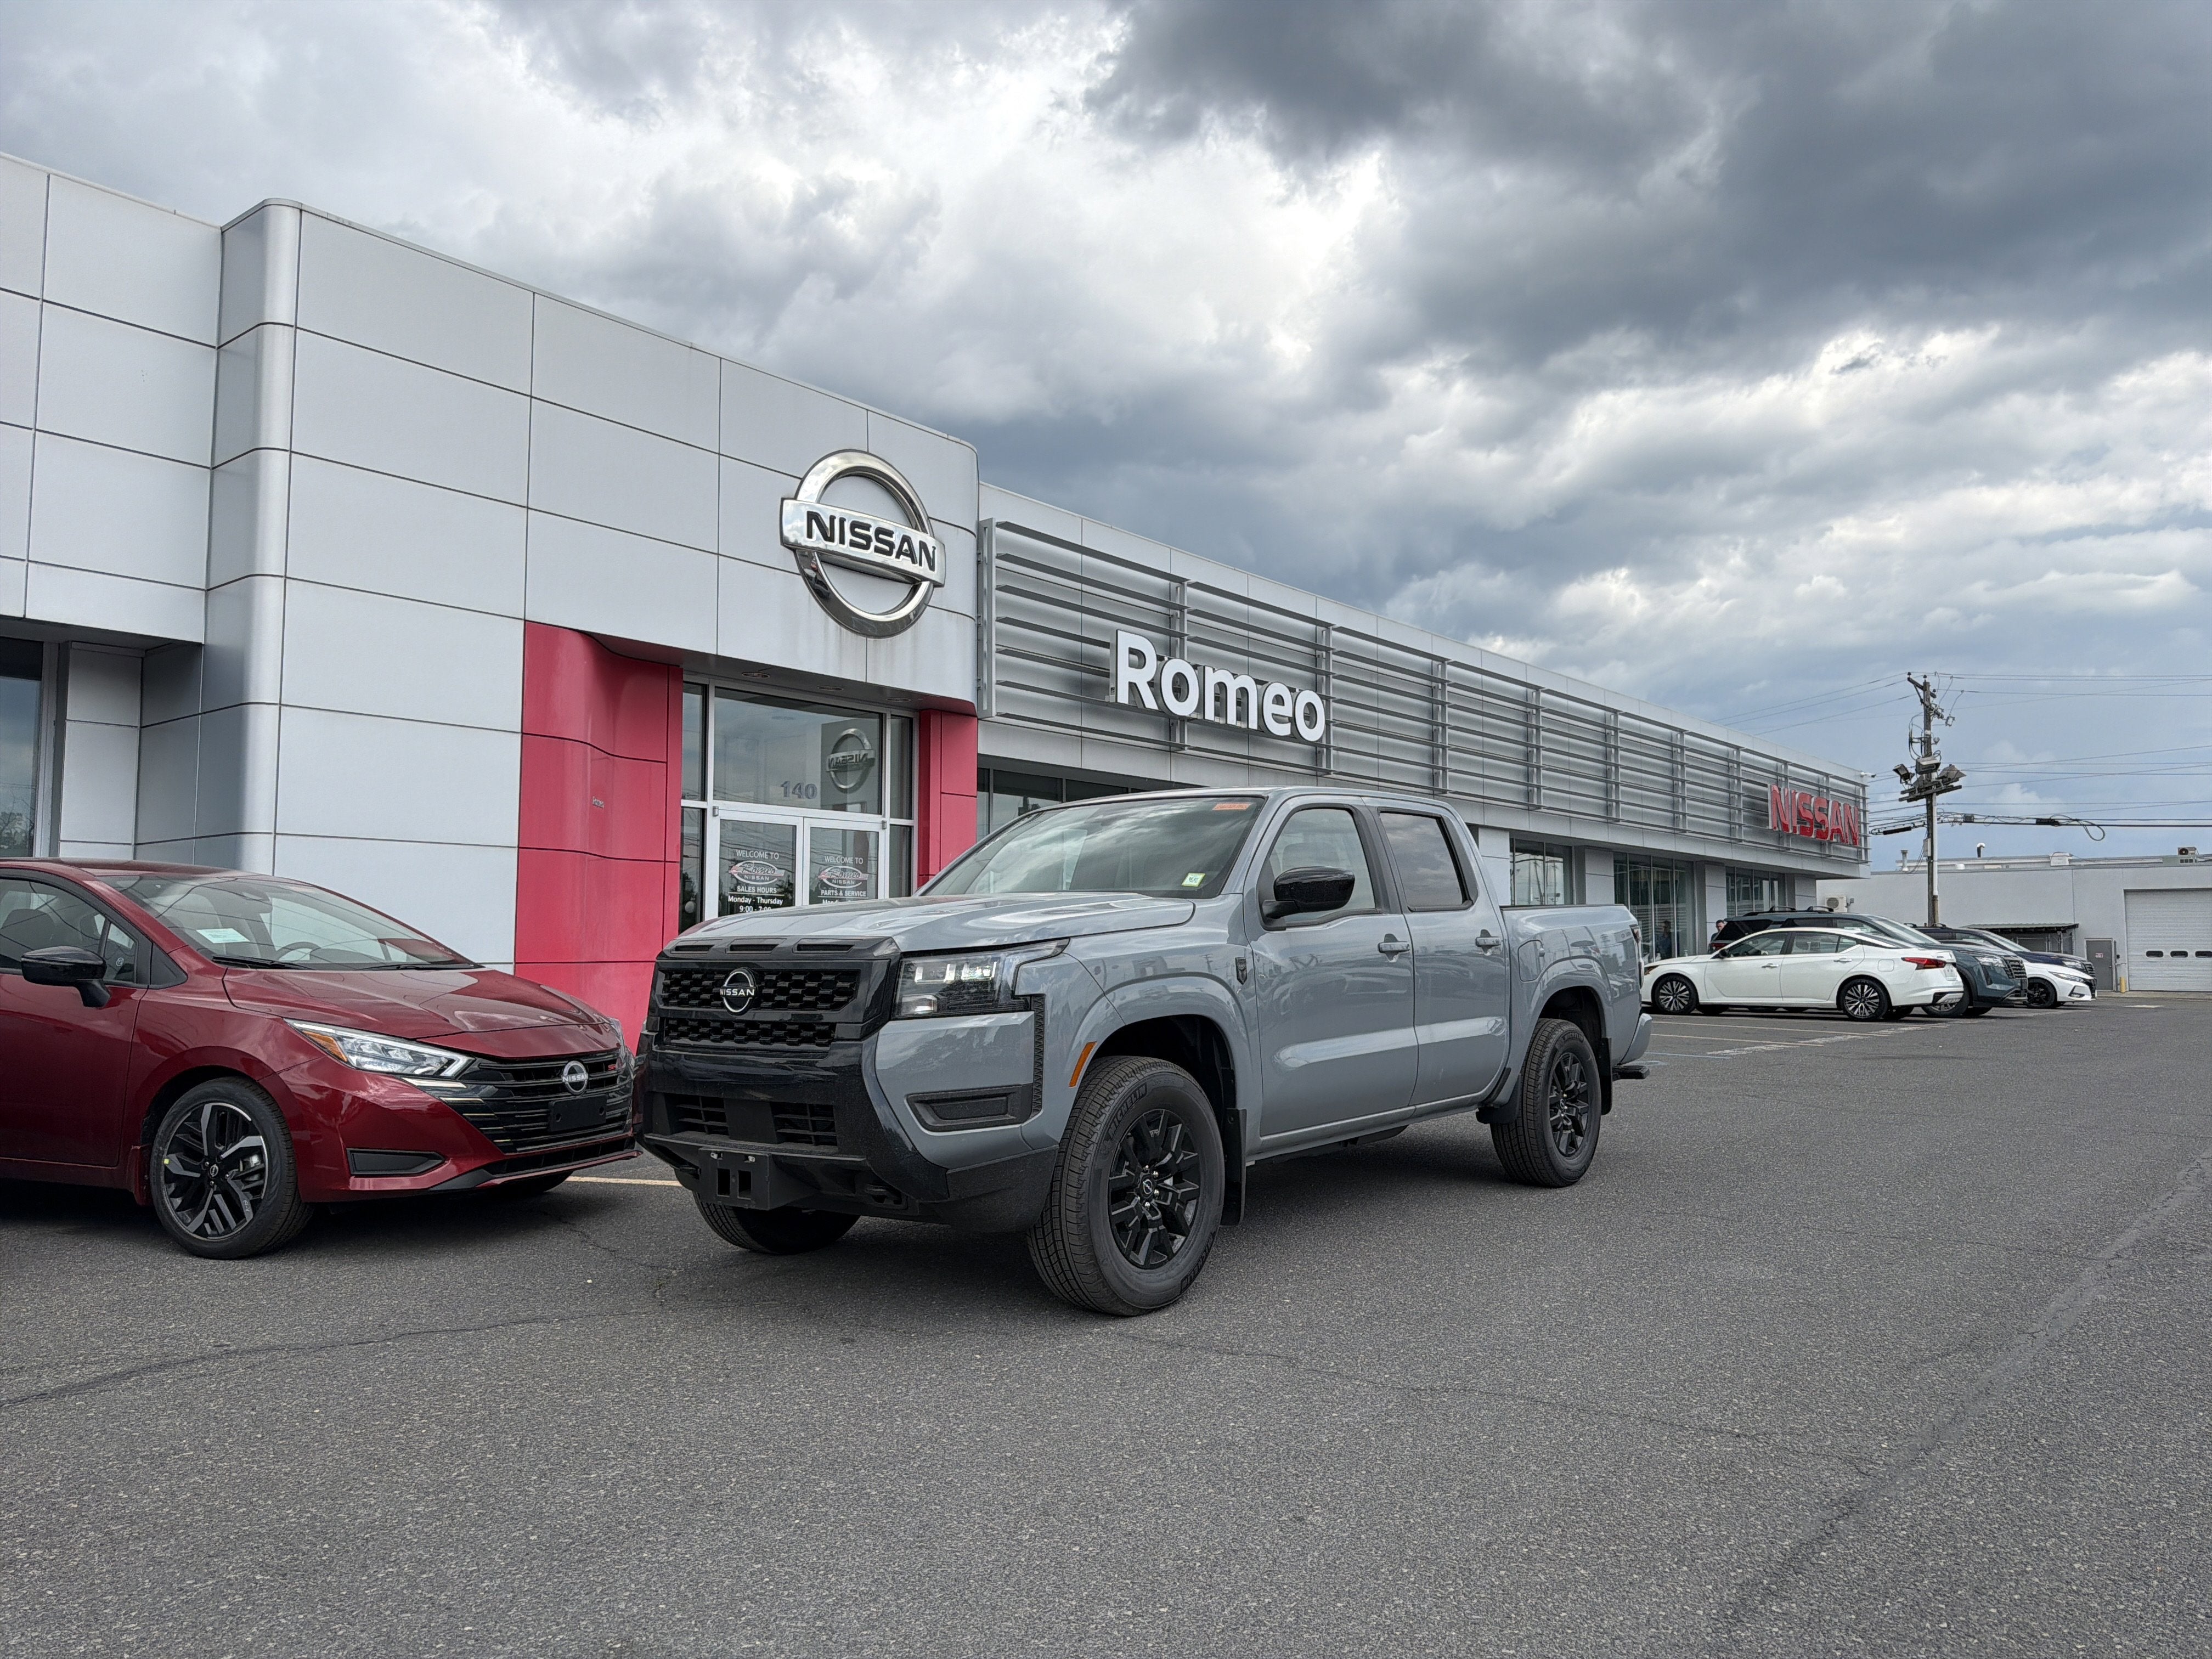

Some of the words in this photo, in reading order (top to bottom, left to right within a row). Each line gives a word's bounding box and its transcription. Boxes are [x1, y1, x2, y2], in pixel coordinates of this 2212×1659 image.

[806, 511, 936, 572] NISSAN
[1115, 629, 1325, 742] Romeo
[781, 781, 817, 799] 140
[1770, 783, 1859, 847] NISSAN
[736, 850, 768, 859] WELCOME
[741, 862, 776, 874] Romeo
[830, 868, 860, 878] Romeo
[728, 895, 752, 904] Monday
[757, 897, 783, 905] Thursday
[562, 1074, 588, 1082] NISSAN
[1108, 1084, 1147, 1138] MICHELIN
